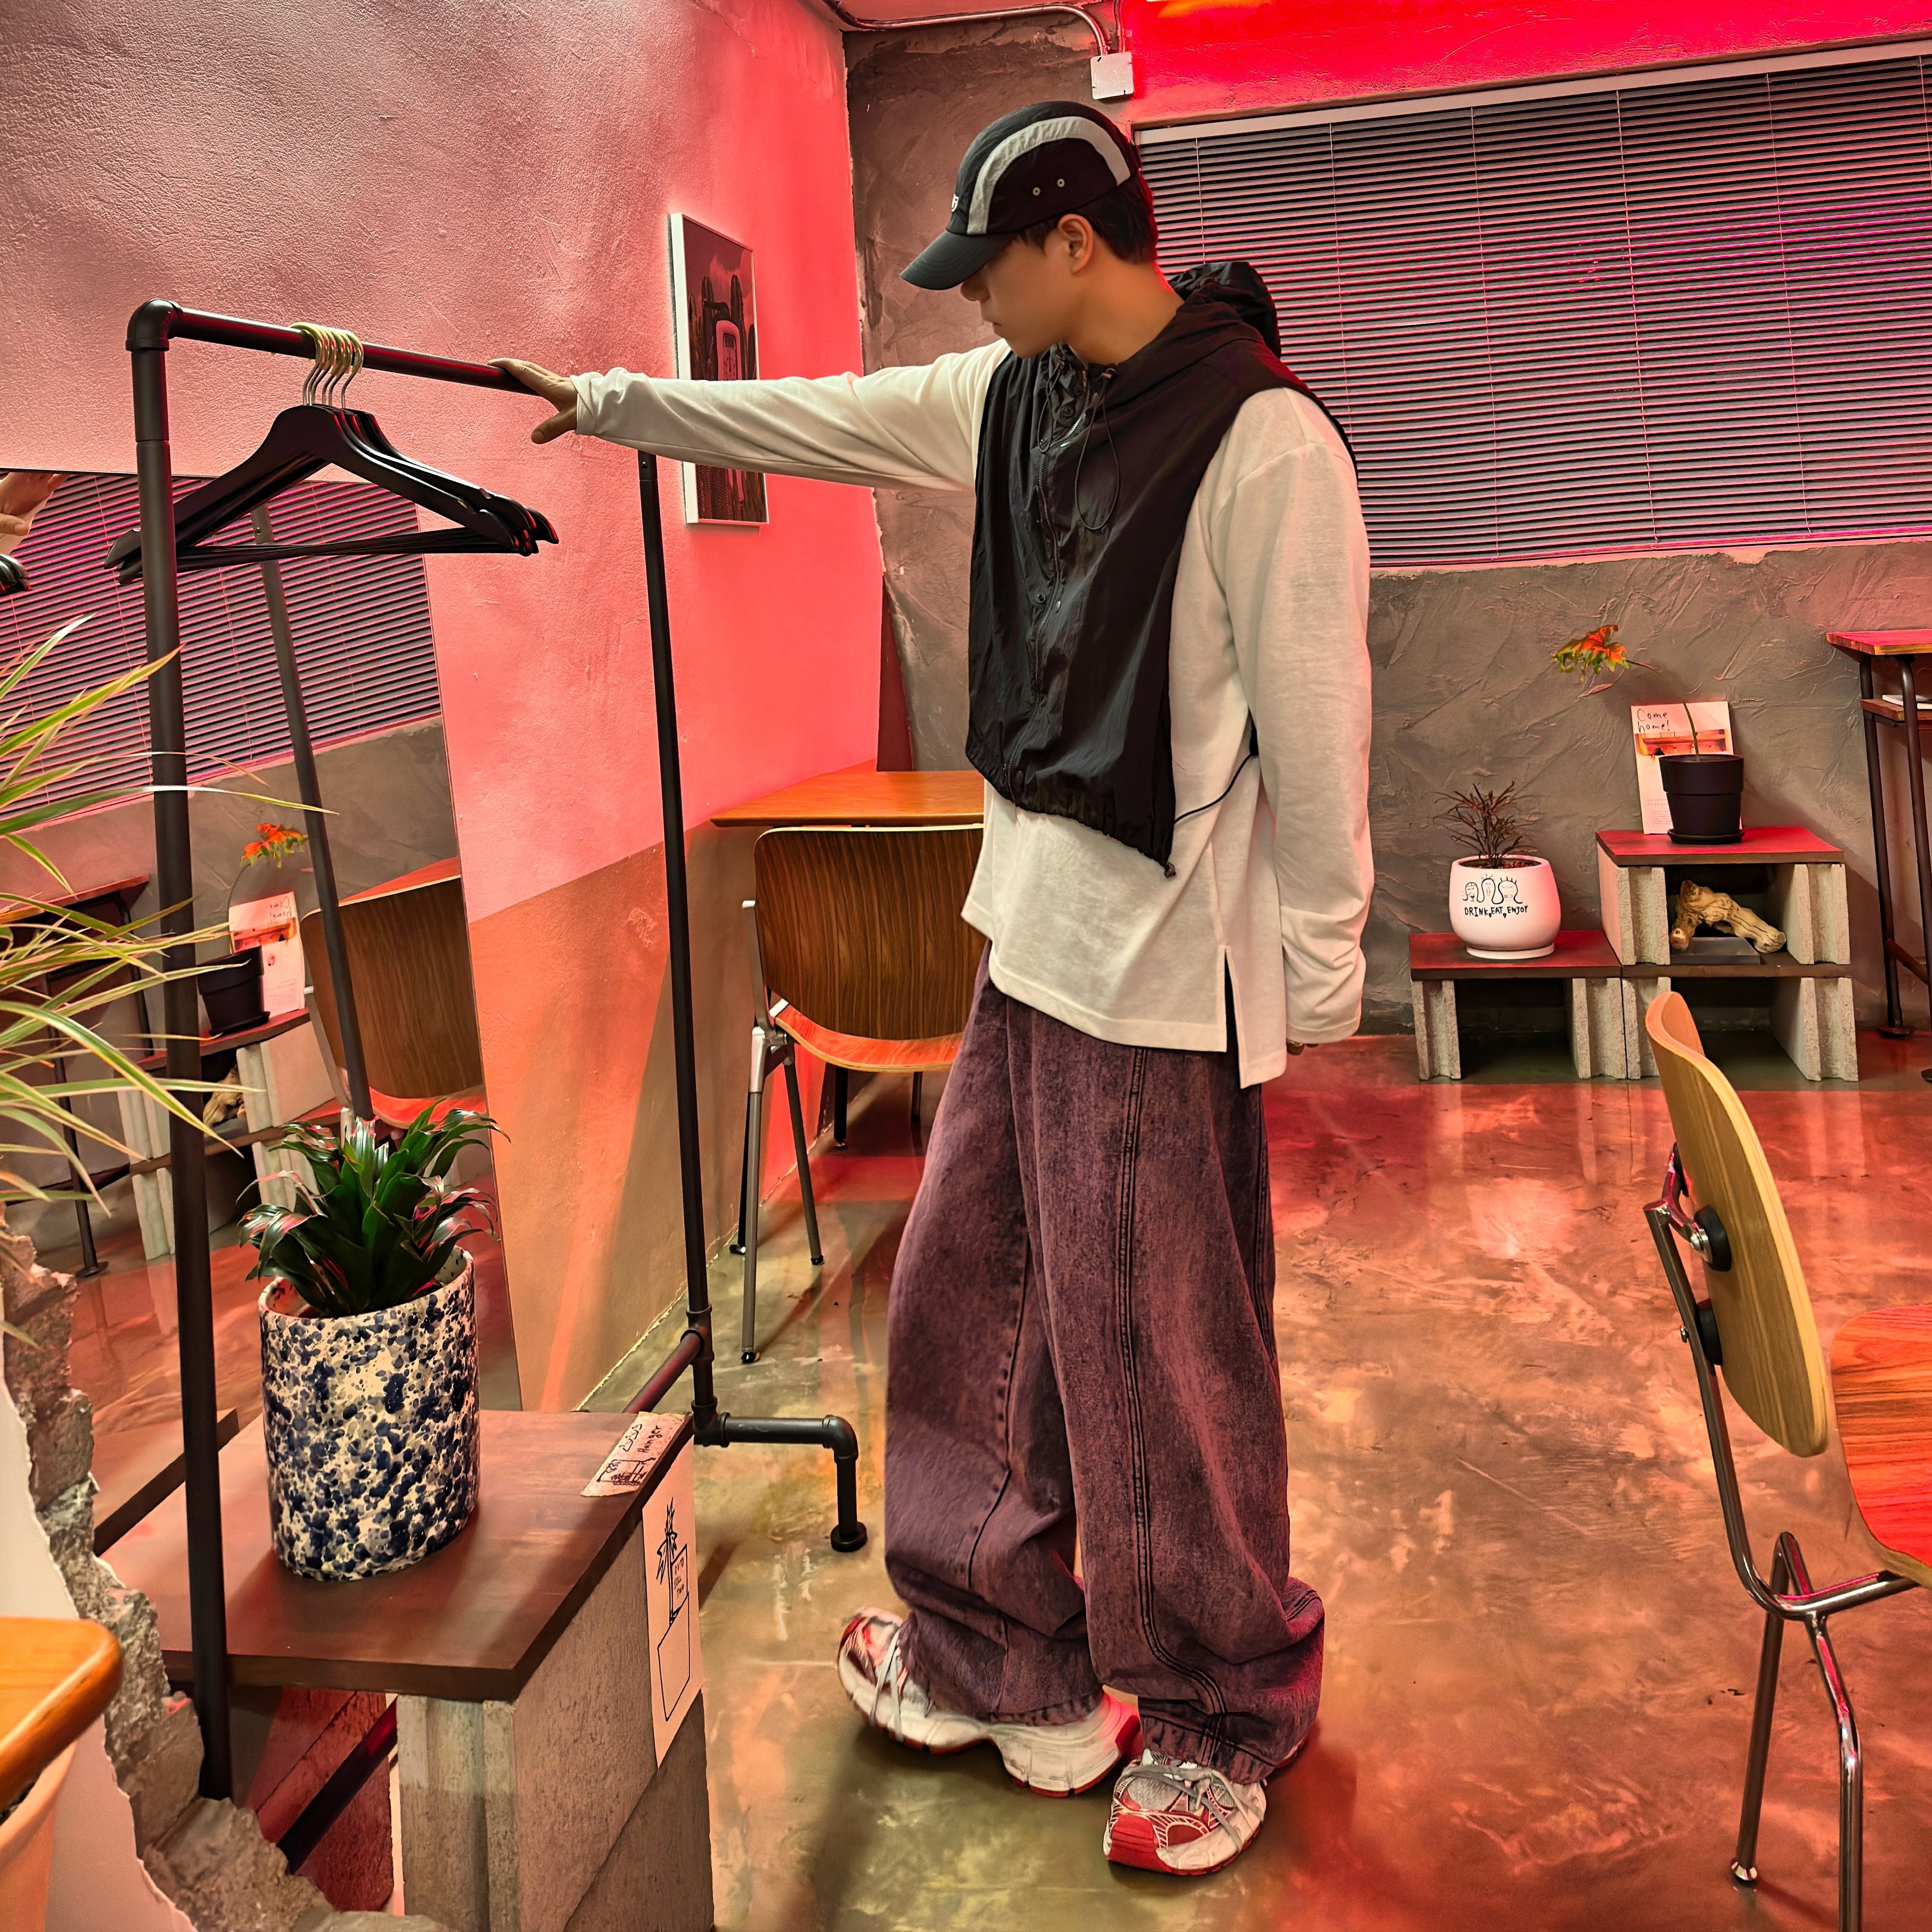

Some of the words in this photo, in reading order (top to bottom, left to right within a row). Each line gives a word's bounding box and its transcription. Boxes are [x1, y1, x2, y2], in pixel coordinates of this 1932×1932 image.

[1637, 709, 1667, 721] Come
[1638, 721, 1670, 733] home!
[1507, 905, 1528, 915] ENJOY
[637, 1425, 663, 1453] Hanger
